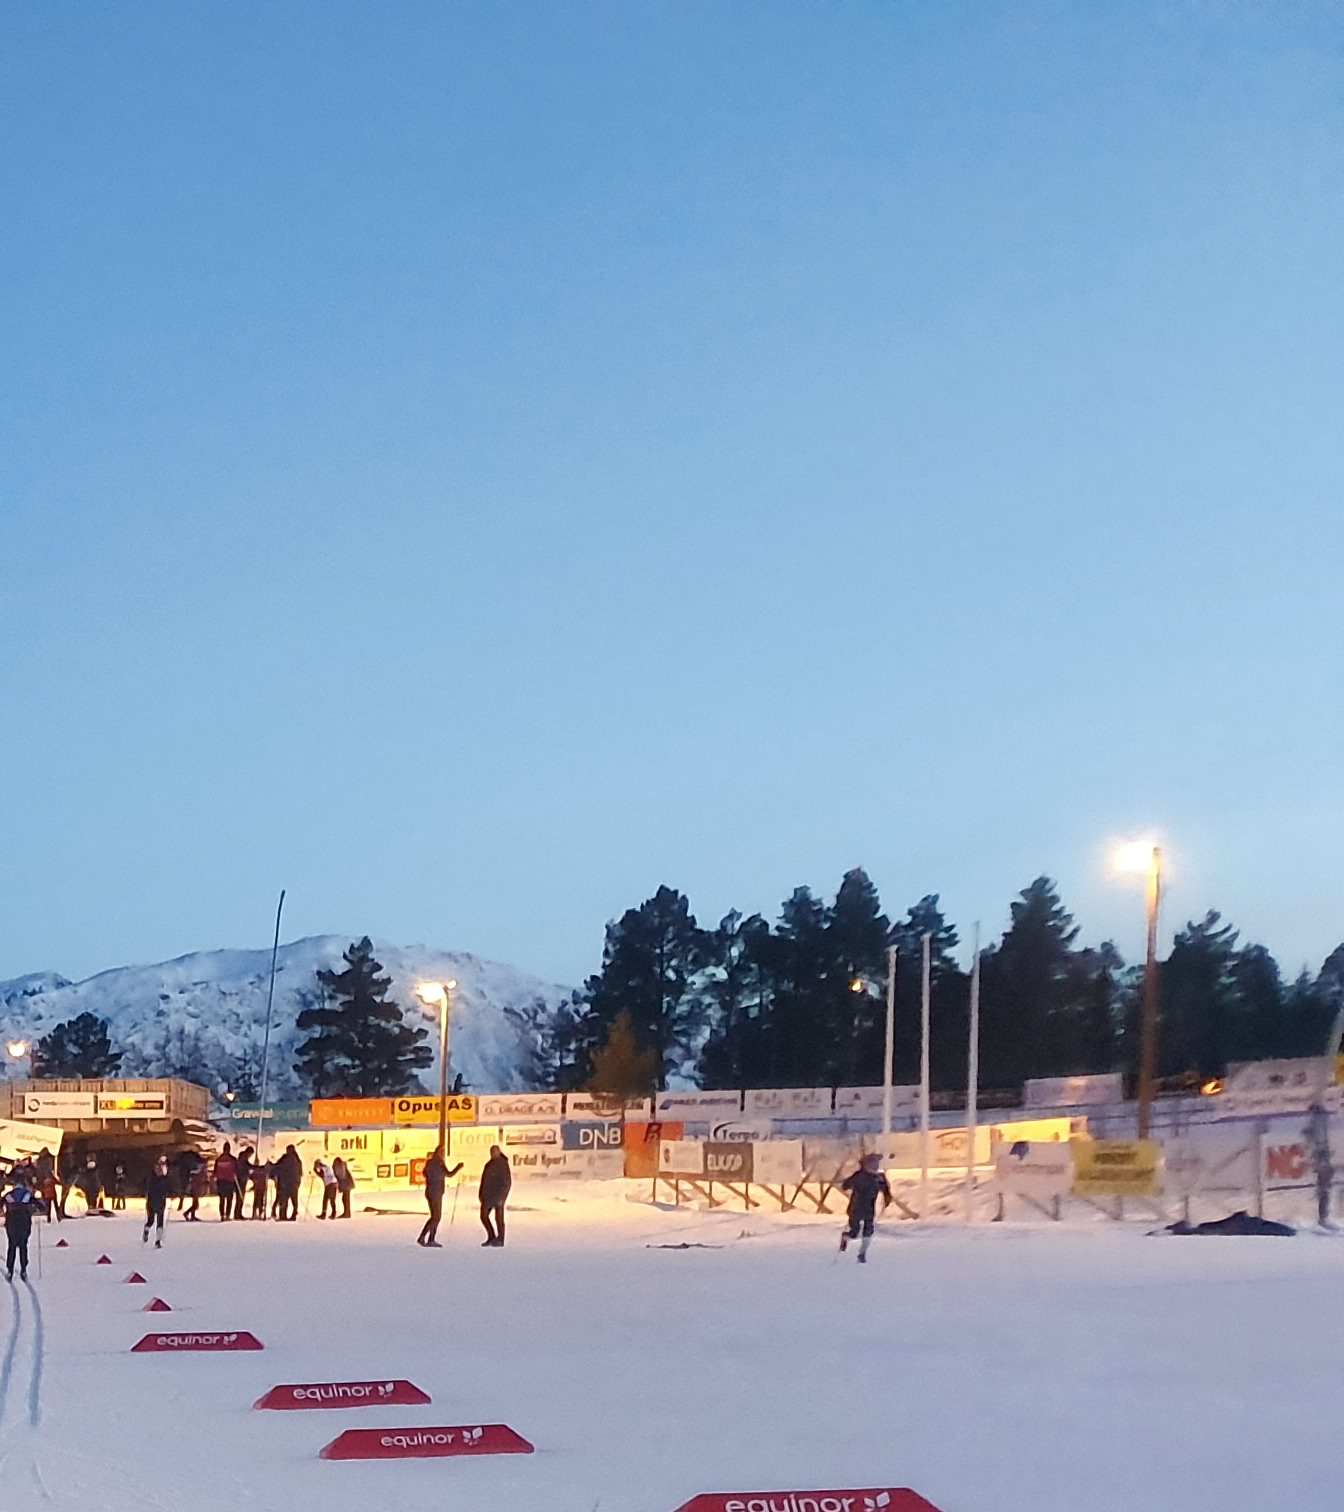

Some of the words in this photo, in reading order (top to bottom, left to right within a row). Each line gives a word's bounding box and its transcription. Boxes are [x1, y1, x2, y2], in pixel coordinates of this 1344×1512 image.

[448, 1098, 473, 1110] AS
[579, 1123, 621, 1149] DNB
[156, 1333, 220, 1348] equinor
[293, 1383, 373, 1402] equinor
[380, 1430, 454, 1448] equinor
